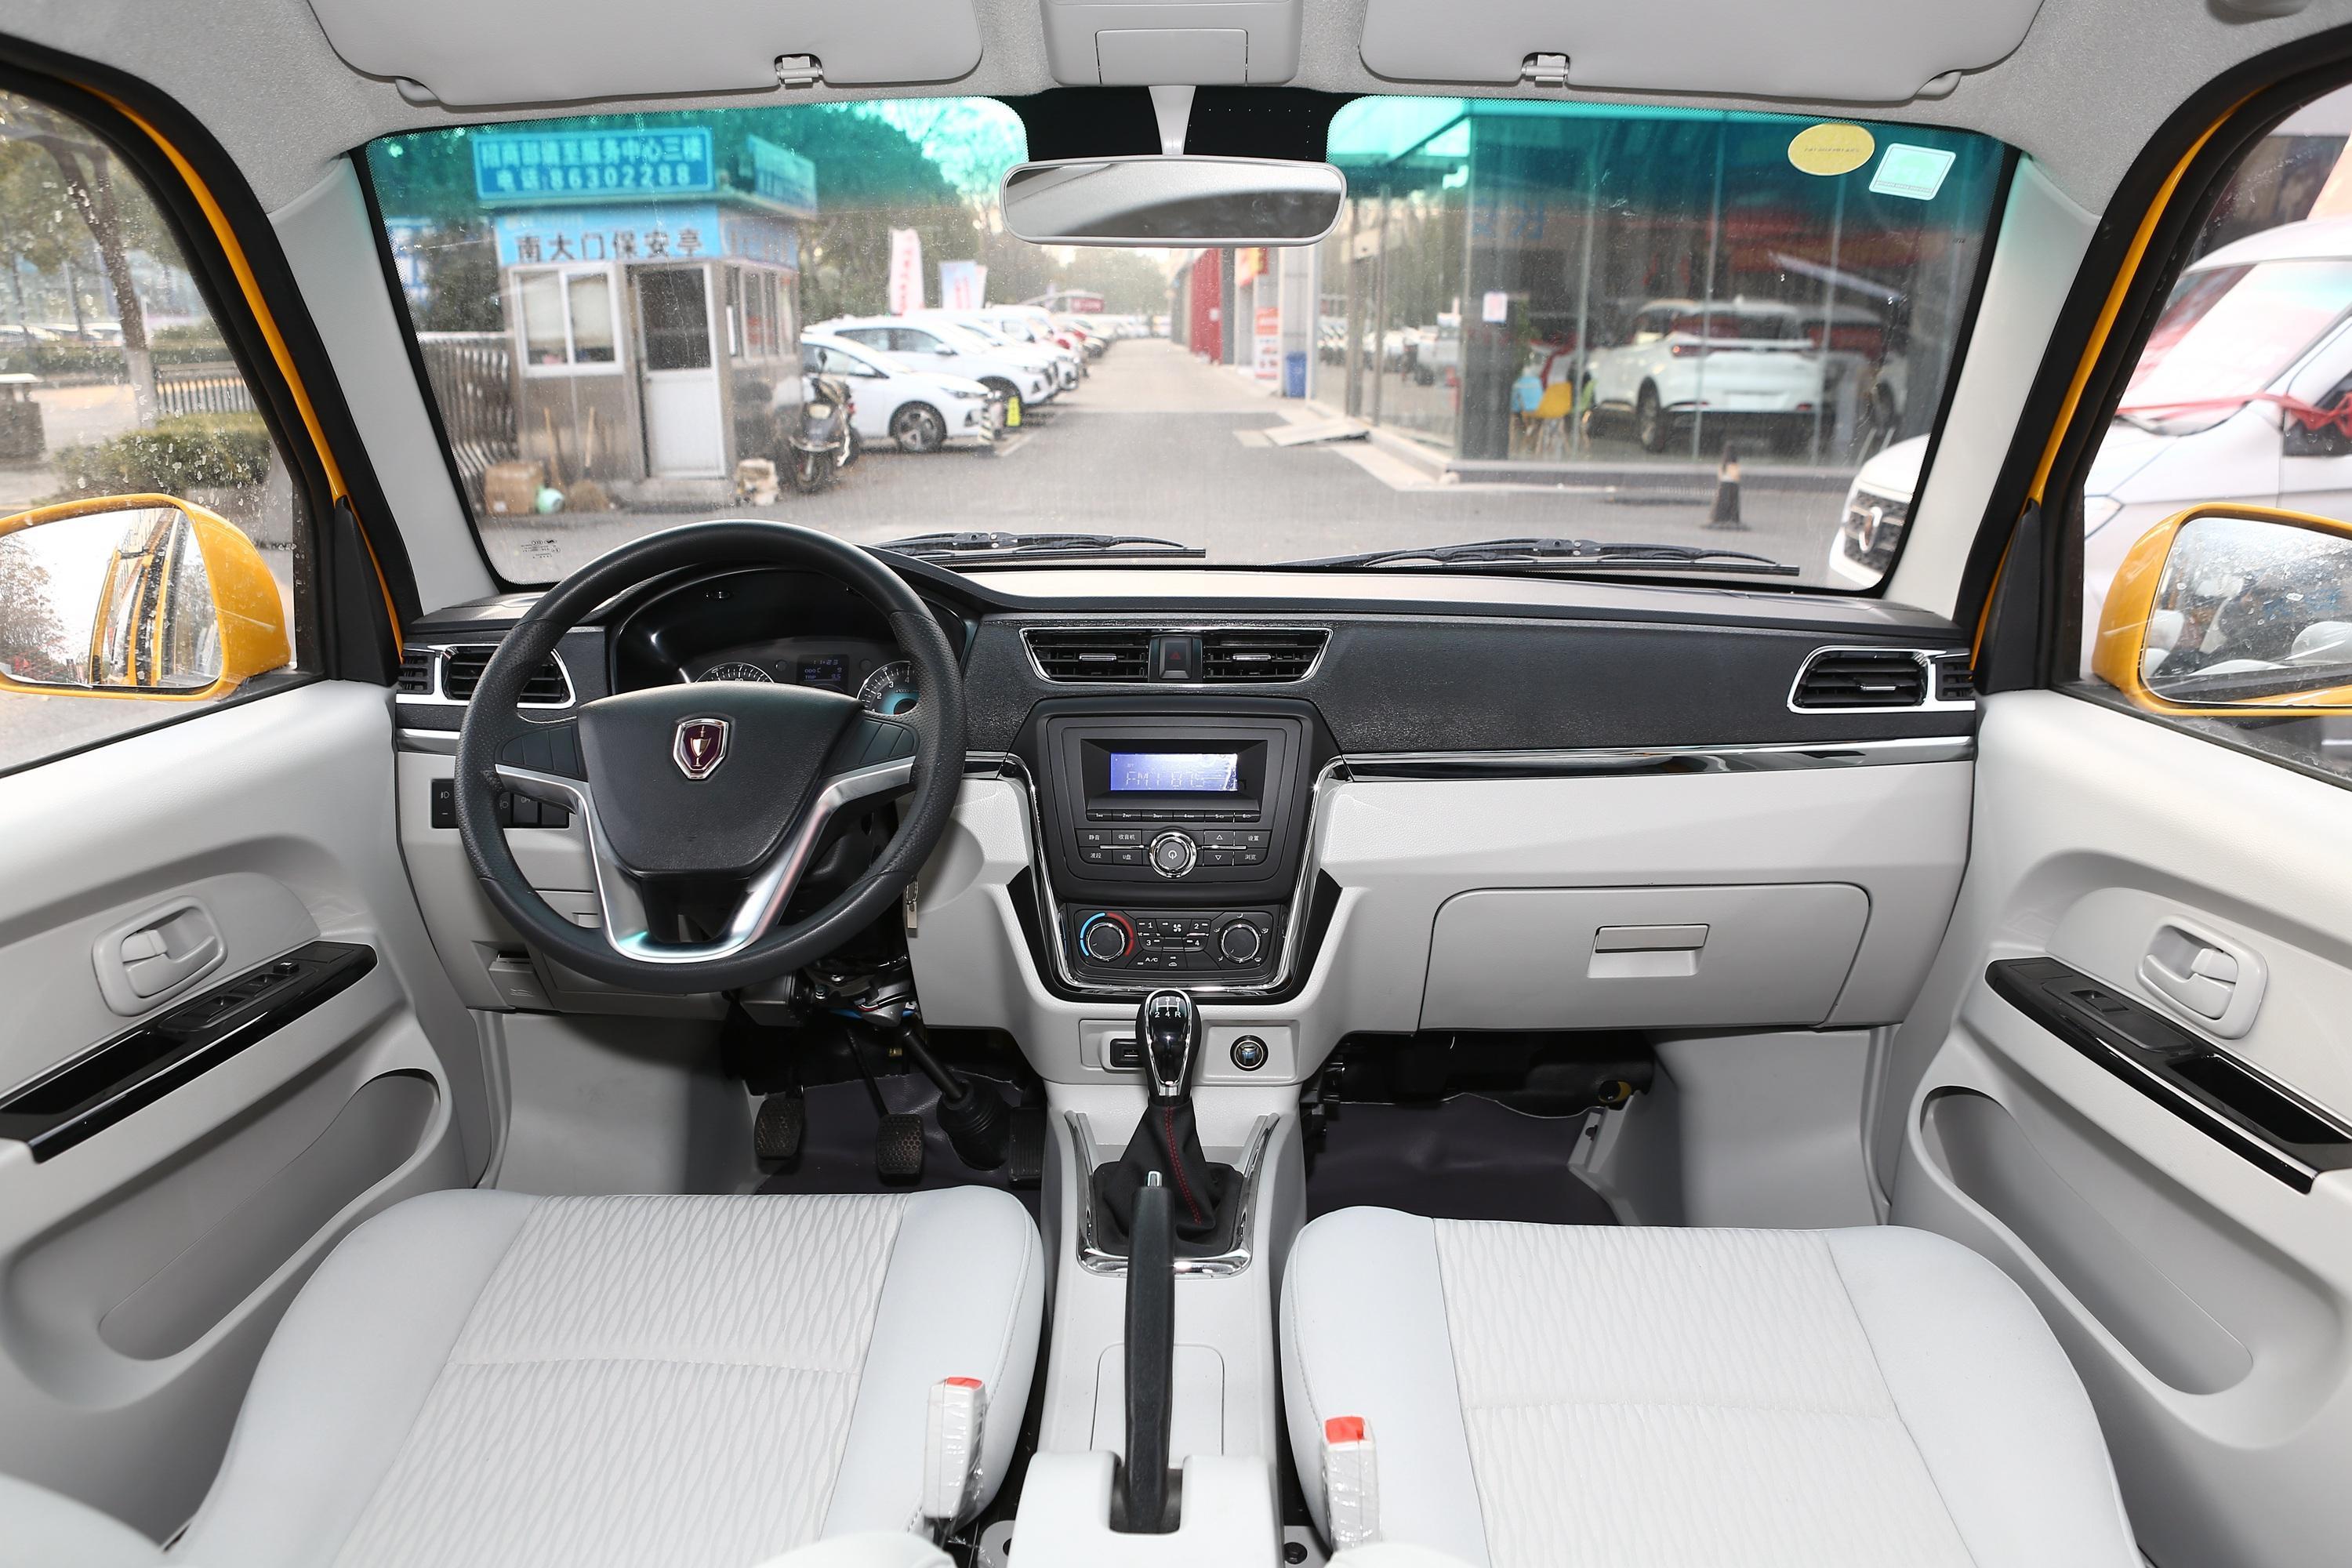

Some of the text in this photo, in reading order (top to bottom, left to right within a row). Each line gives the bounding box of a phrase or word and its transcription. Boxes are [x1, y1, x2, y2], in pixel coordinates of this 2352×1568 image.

[517, 227, 702, 263] 南大门保安亭
